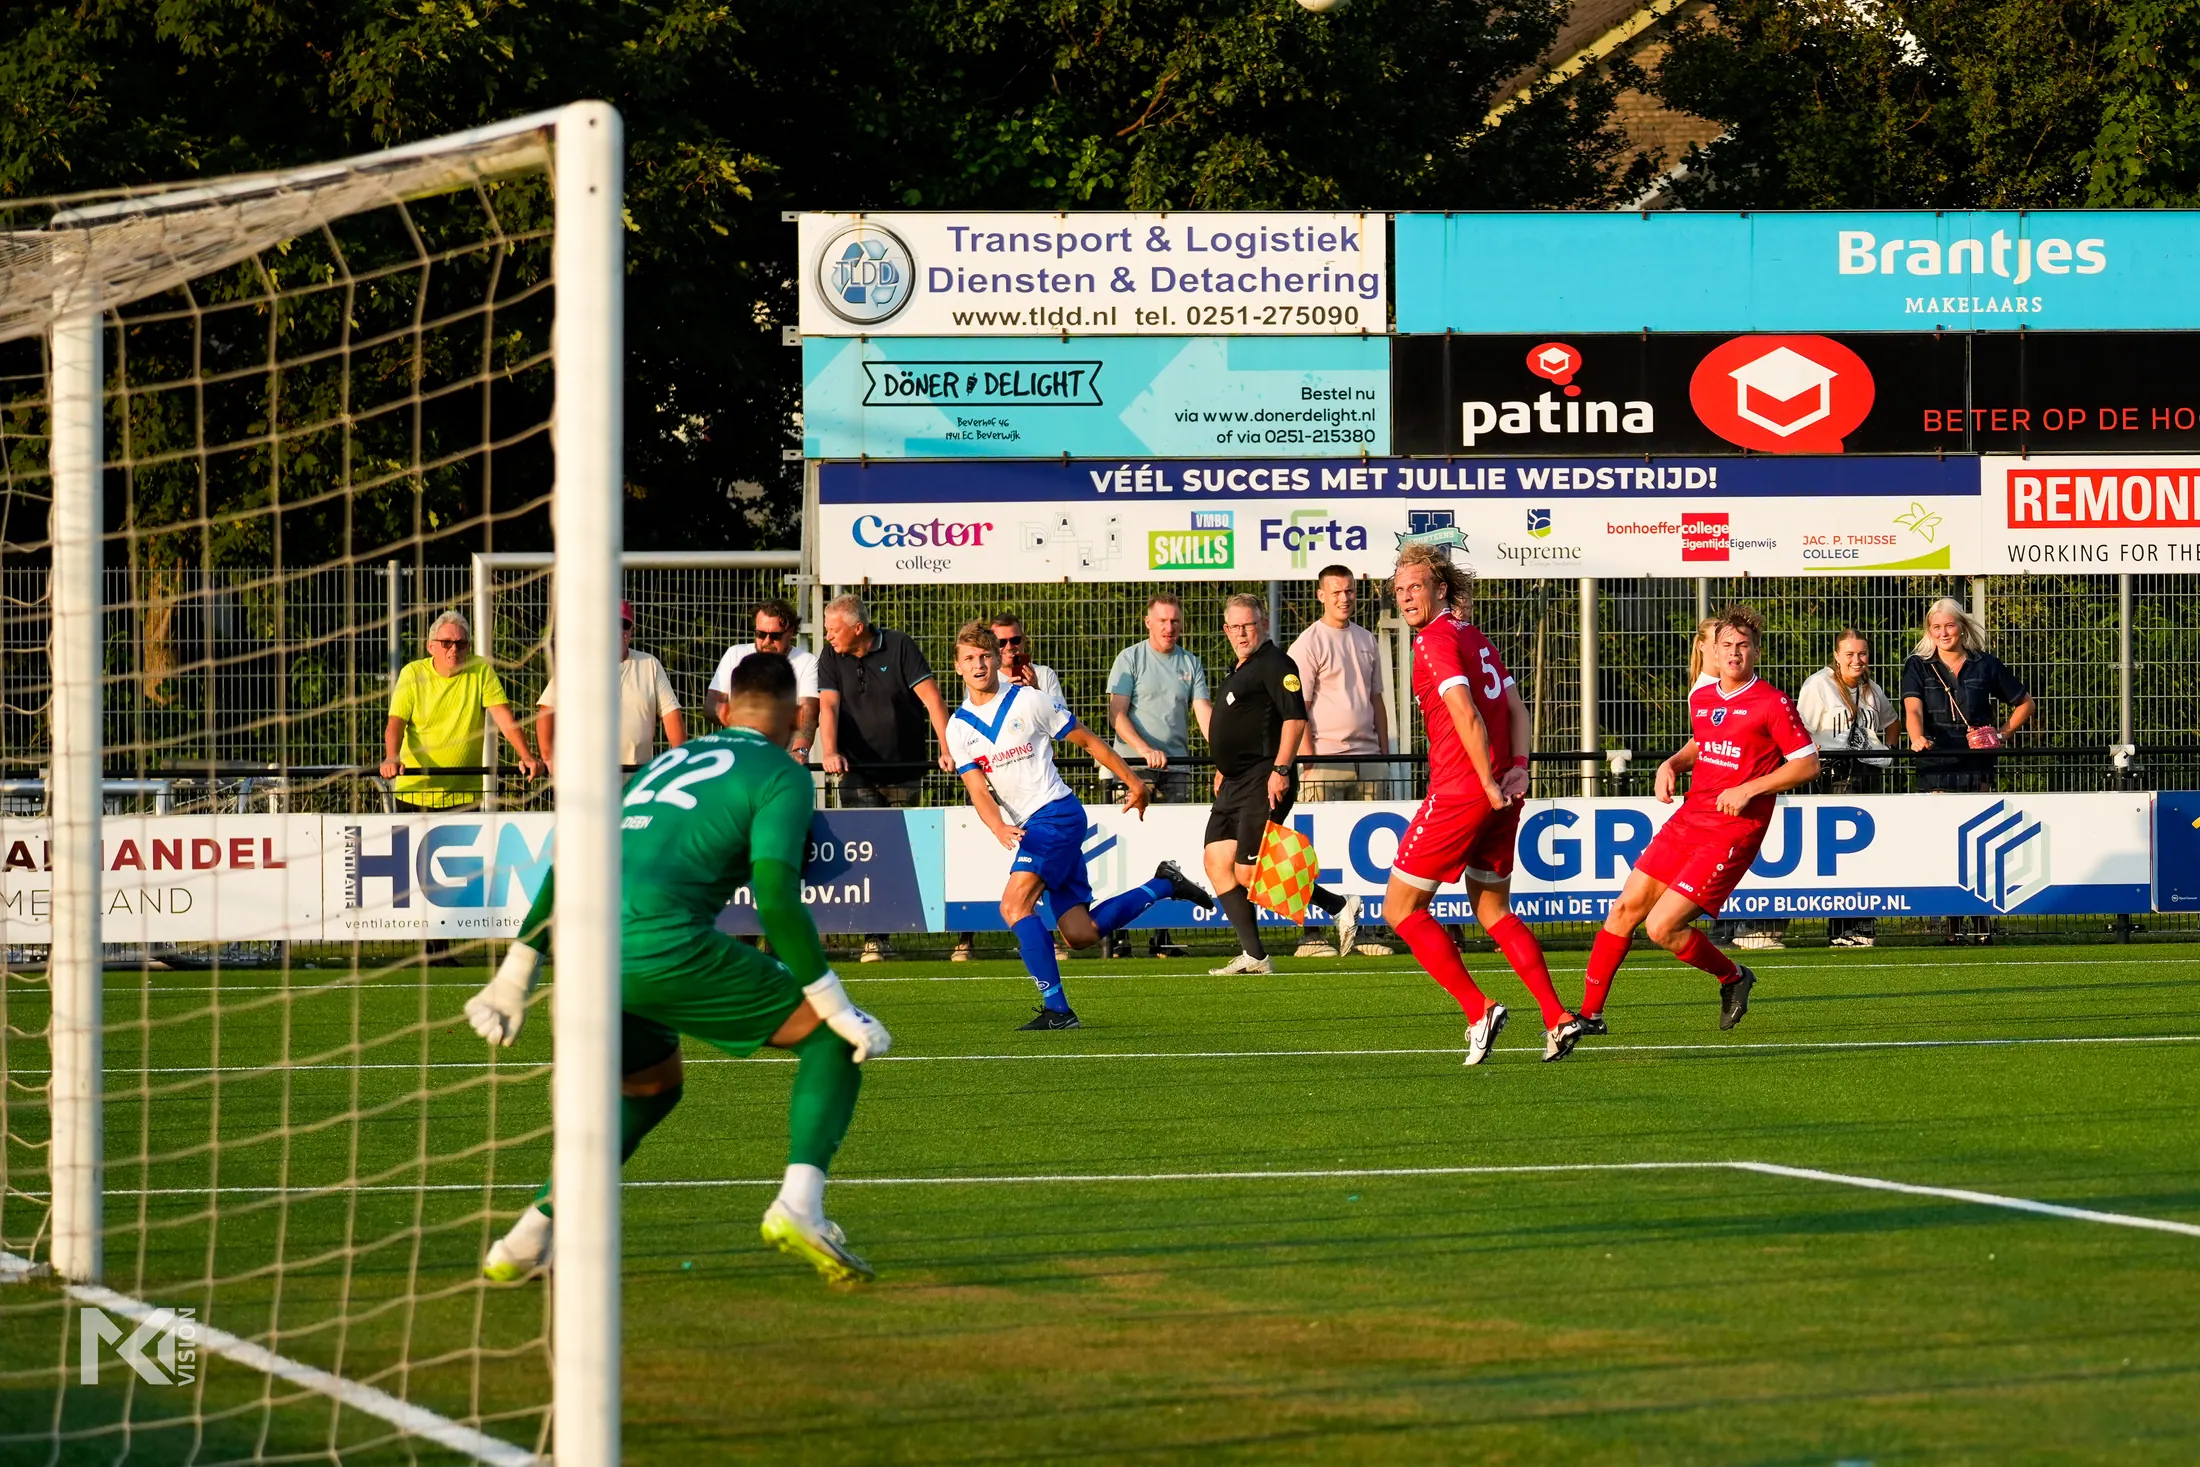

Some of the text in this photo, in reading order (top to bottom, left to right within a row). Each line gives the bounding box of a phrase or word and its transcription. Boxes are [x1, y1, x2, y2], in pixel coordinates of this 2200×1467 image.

[947, 226, 1360, 262] Transport & Logistiek
[1839, 228, 2106, 284] Brantjes
[836, 261, 893, 285] TLDD
[929, 266, 1378, 299] Diensten & Detachering
[953, 305, 1359, 326] www.tldd.nl tel. 0251-275090
[1905, 296, 2042, 313] MAKELAARS
[884, 370, 1085, 398] DÖNER DELIGHT
[1302, 387, 1374, 400] Bestel nu
[957, 417, 1009, 427] Beverhof 46
[1175, 408, 1375, 426] via www.donerdelight.nl
[1463, 393, 1653, 446] patina
[1925, 408, 2200, 432] BETER OP DE HO
[944, 432, 961, 440] 1941
[962, 431, 973, 439] EC
[1217, 429, 1375, 443] of via 0251-215380
[1090, 464, 1716, 492] VÉÉL SUCCES MET JULLIE WEDSTRIJD!
[2014, 475, 2200, 522] REMON
[852, 515, 993, 550] Castor
[1195, 513, 1230, 528] VMBO
[1260, 518, 1367, 552] Forta
[1803, 535, 1896, 545] JAC. P. THIJSSE
[1155, 535, 1228, 565] SKILLS
[1497, 542, 1581, 566] Supreme
[1803, 549, 1859, 558] COLLEGE
[2008, 545, 2108, 562] WORKING
[2121, 544, 2157, 561] FOR
[896, 556, 951, 573] college
[1479, 647, 1502, 700] 5
[623, 747, 735, 809] 22
[844, 841, 873, 862] 69
[1192, 907, 1217, 921] OP
[1545, 900, 1563, 915] IN
[1569, 899, 1593, 914] DE
[1746, 897, 1769, 912] OP
[1774, 895, 1911, 911] BLOKGROUP.NL
[346, 919, 428, 929] ventilatoren
